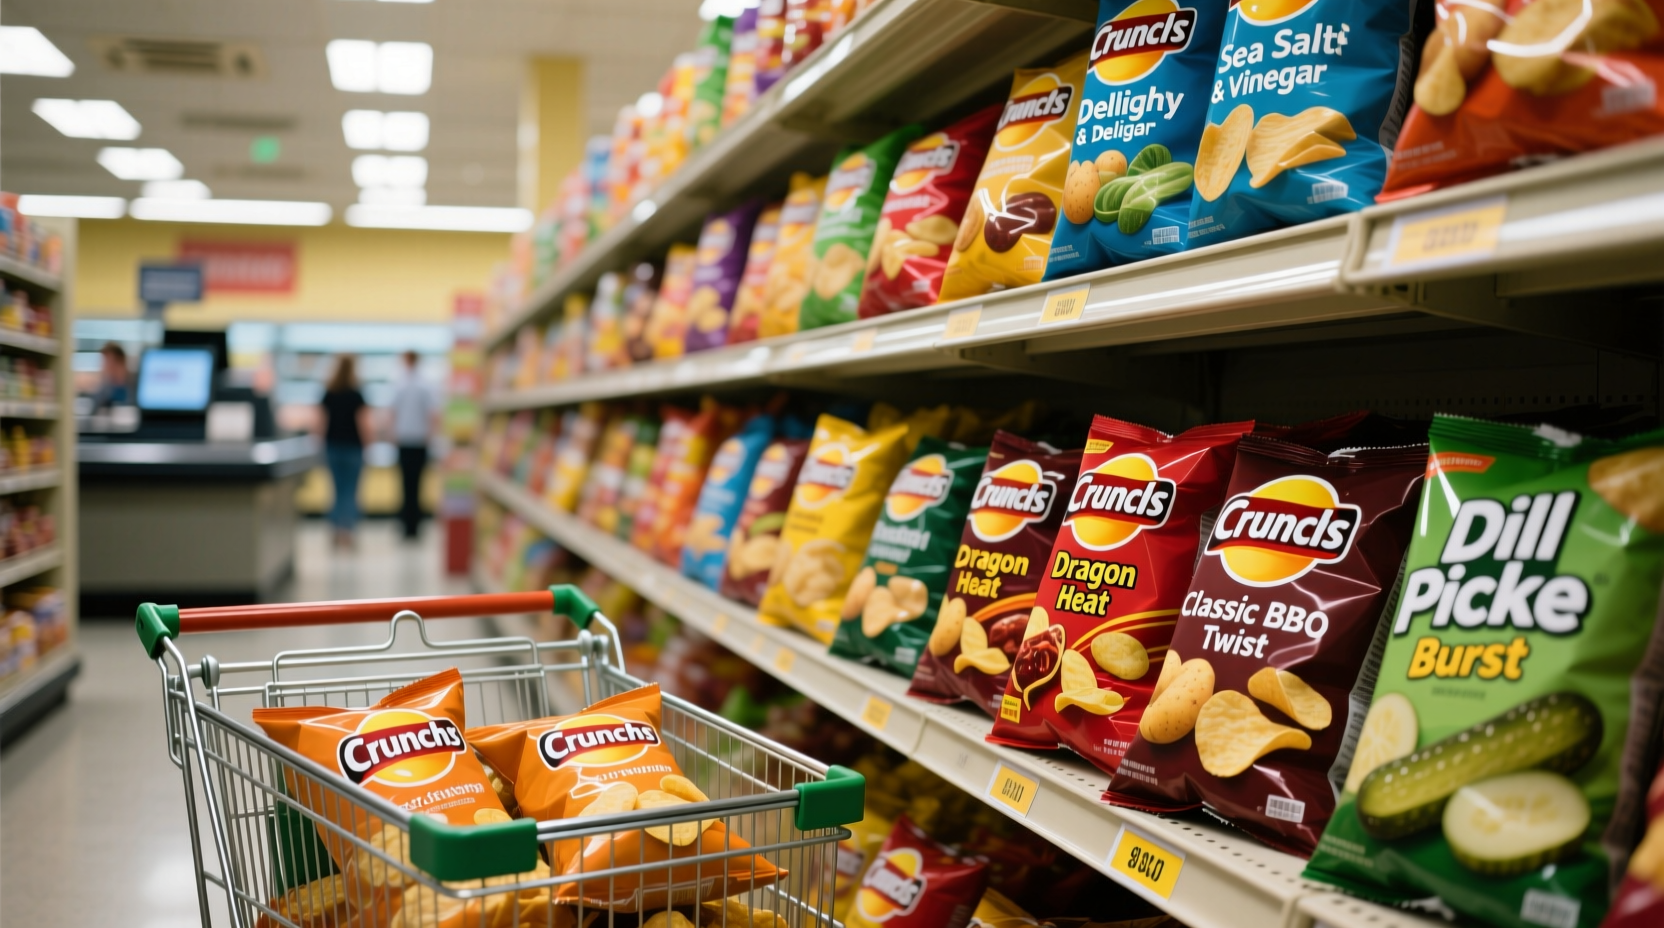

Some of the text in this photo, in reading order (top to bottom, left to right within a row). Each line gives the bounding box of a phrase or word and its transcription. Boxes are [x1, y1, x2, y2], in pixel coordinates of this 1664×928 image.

[1090, 12, 1190, 60] Cruncls
[1218, 42, 1264, 74] Sea
[1211, 64, 1327, 104] & Vinegar
[1076, 86, 1184, 125] Dellighy
[1076, 121, 1156, 145] & Deligar
[971, 475, 1049, 513] Cruncls
[1068, 475, 1168, 517] Cruncls
[1214, 499, 1350, 550] Cruncls
[1440, 491, 1576, 564] Dill
[954, 544, 1030, 577] Dragon
[1051, 551, 1136, 588] Dragon
[955, 570, 1001, 599] Heat
[1055, 585, 1109, 615] Heat
[1393, 560, 1588, 634] Picke
[1181, 590, 1260, 625] Classic
[1203, 624, 1269, 659] Twist
[1407, 637, 1530, 680] Burst
[345, 721, 461, 773] Crunchs
[546, 723, 654, 757] Crunchs
